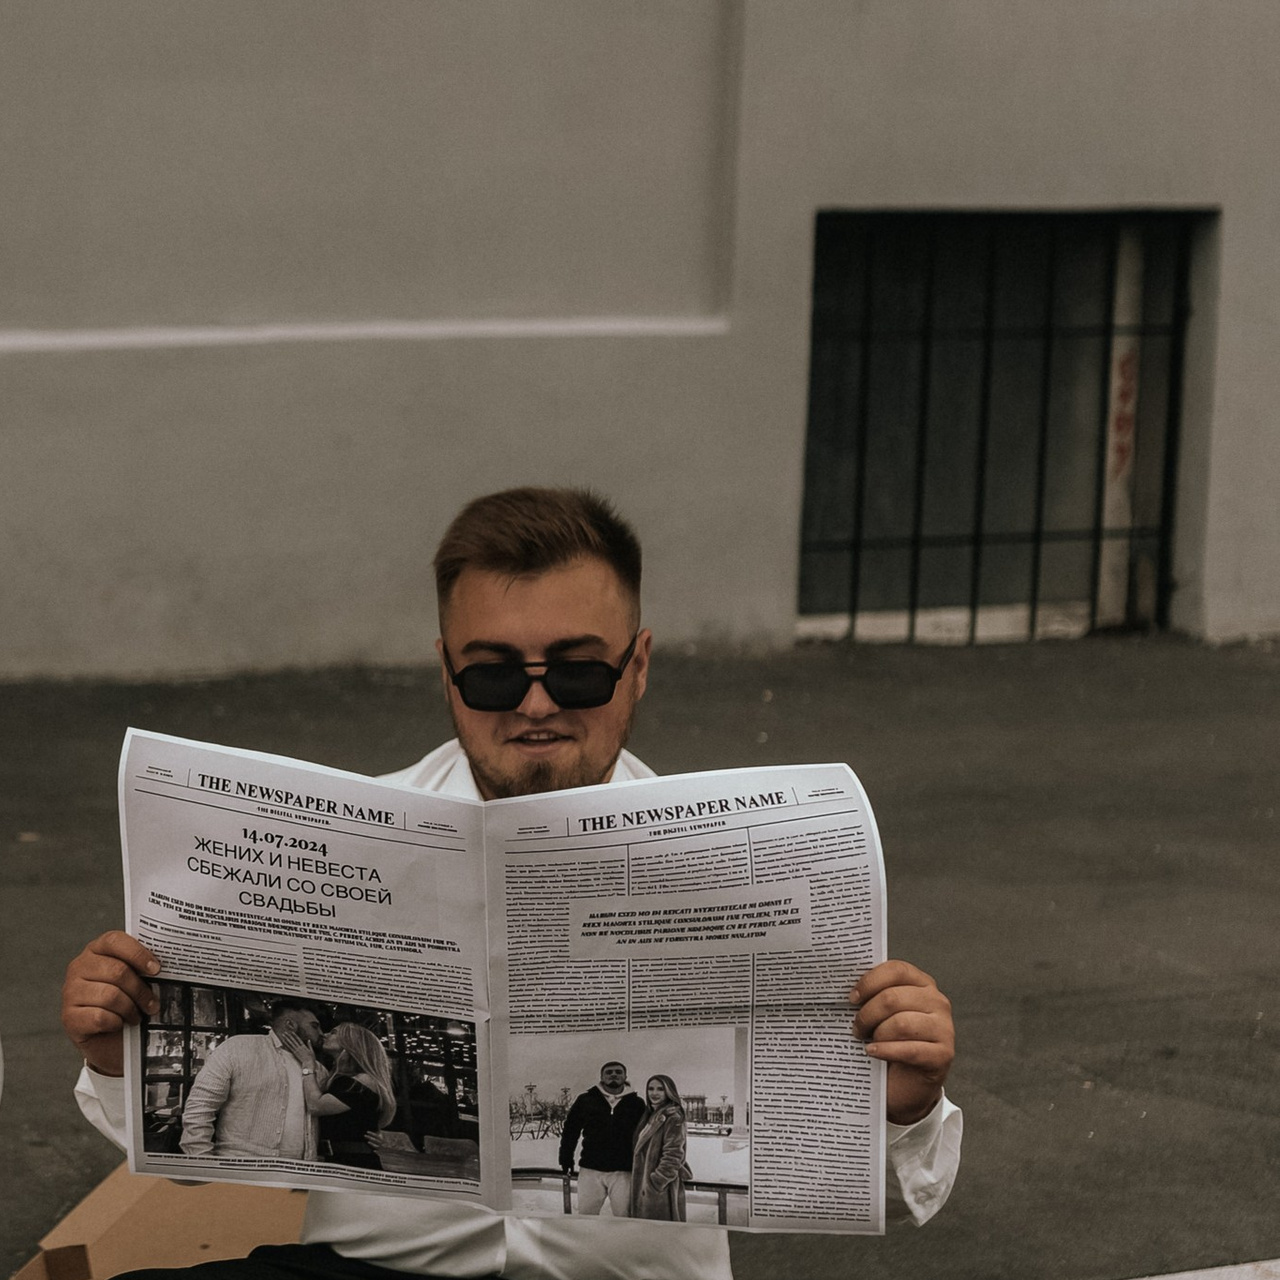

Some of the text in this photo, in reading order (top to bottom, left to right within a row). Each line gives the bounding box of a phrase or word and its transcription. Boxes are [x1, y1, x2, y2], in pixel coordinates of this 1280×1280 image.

[198, 773, 395, 826] THE NEWSPAPER NAME
[578, 814, 617, 832] THE
[622, 798, 731, 827] NEWSPAPER
[734, 791, 787, 810] NAME
[194, 835, 381, 883] ЖЕНИХ И НЕВЕСТА
[242, 827, 328, 856] 14.07.2024
[186, 857, 392, 905] СБЕЖАЛИ СО СВОЕЙ
[238, 891, 336, 917] СВАДЬБЫ
